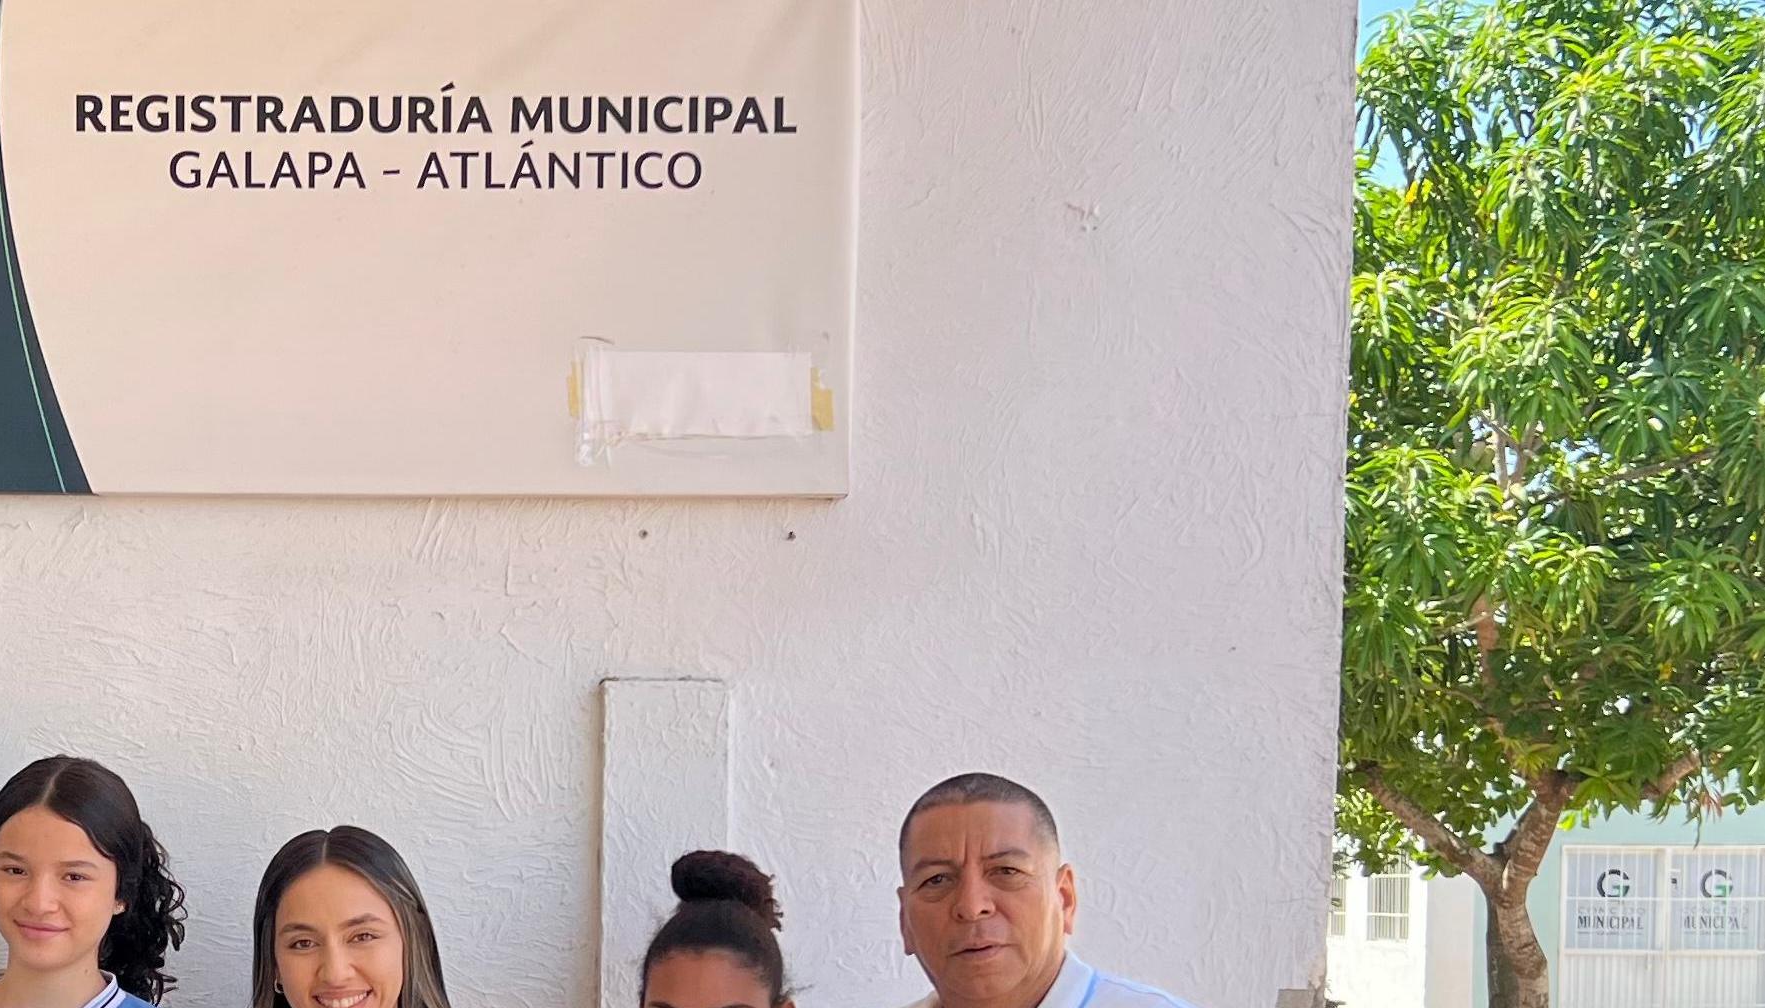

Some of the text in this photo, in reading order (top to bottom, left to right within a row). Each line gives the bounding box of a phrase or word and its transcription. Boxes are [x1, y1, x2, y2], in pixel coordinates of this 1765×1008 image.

[75, 81, 798, 135] REGISTRADURÍA MUNICIPAL
[168, 150, 367, 190] GALAPA
[416, 139, 703, 190] ATLÁNTICO
